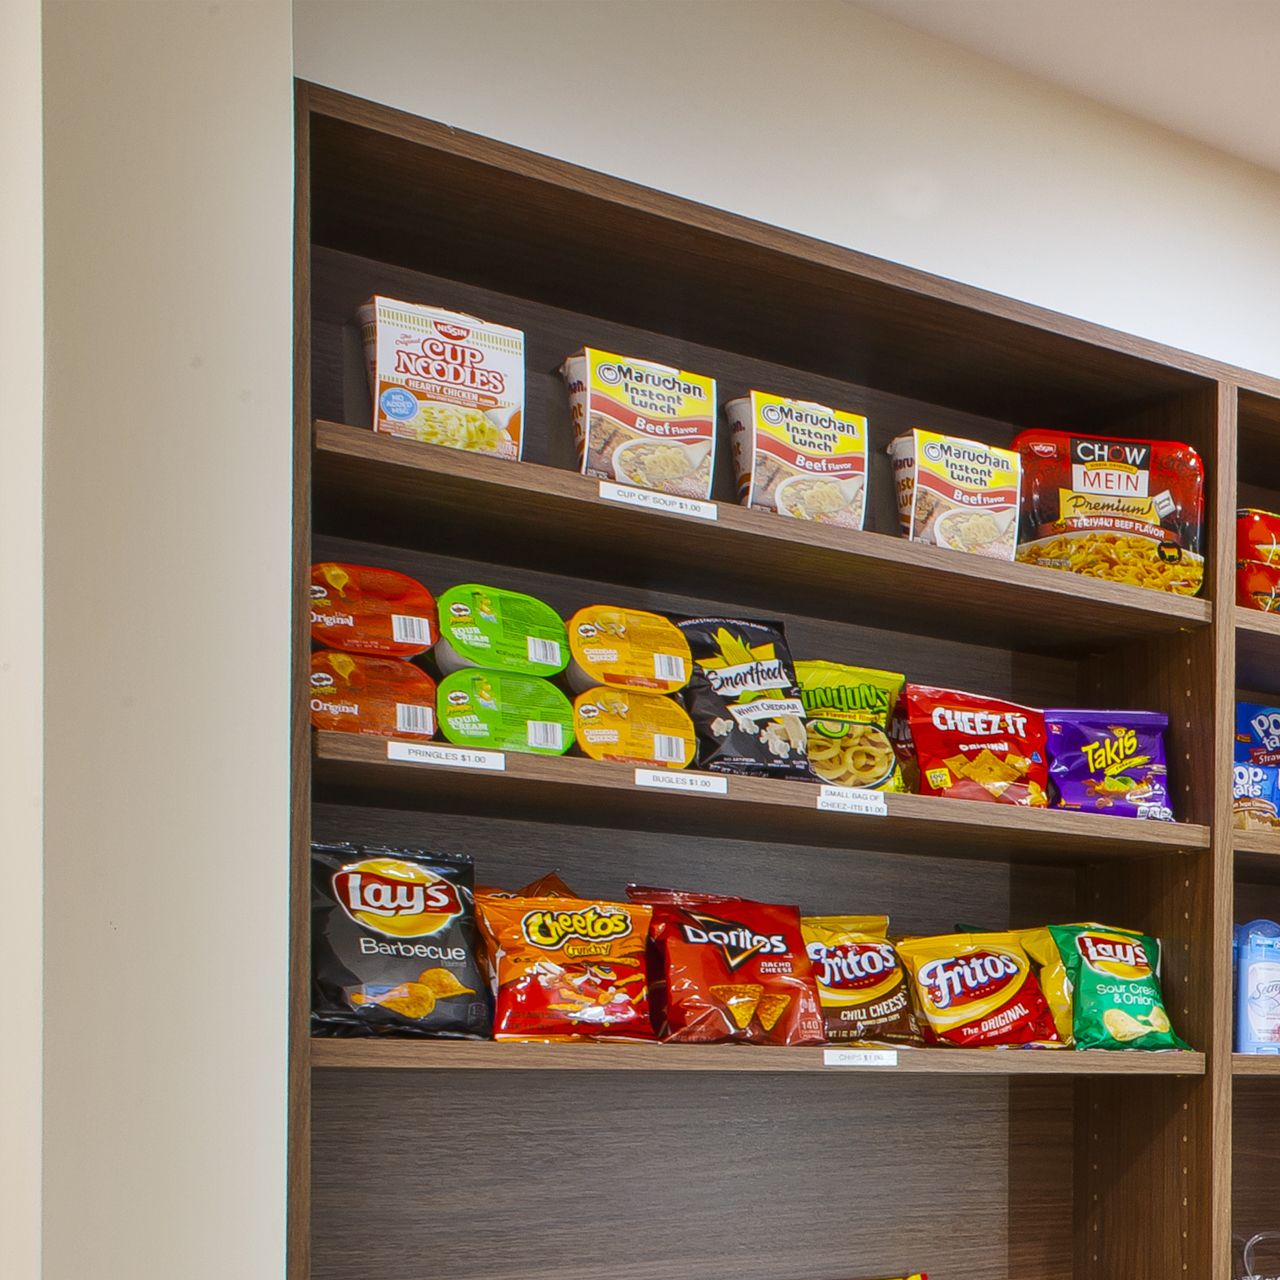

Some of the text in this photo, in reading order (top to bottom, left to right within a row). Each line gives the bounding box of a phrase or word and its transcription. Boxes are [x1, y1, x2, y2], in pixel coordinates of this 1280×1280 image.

[422, 338, 484, 367] CUP
[395, 350, 505, 394] NOODLES
[617, 364, 704, 398] Maruchan
[409, 380, 478, 401] HEARTY CHICKEN
[623, 383, 682, 406] Instant
[630, 394, 676, 416] Lunch
[635, 417, 697, 436] Beef Flavor
[779, 406, 857, 436] Maruchan
[785, 422, 838, 444] Instant
[791, 434, 832, 453] Lunch
[940, 443, 1011, 471] Maruchan
[1077, 443, 1147, 465] CHOW
[944, 458, 993, 478] Instant
[949, 470, 988, 487] Lunch
[1083, 471, 1139, 491] MEIN
[617, 489, 701, 512] CUP OF SOUP $1.00
[1067, 495, 1152, 515] Premium
[1072, 518, 1113, 529] TERIYAKI
[1135, 523, 1165, 538] FLAVOR
[707, 660, 785, 693] Smartfood
[310, 699, 359, 715] Original
[734, 700, 800, 717] WHITE CHEDDAR
[931, 706, 1028, 738] CHEEZ-IT
[408, 748, 486, 764] PRINGLES $1.00
[1081, 733, 1138, 774] Takis
[652, 774, 711, 788] BUGLES $1.00
[821, 801, 863, 811] CHEEZ-ITS
[348, 873, 449, 916] Lay's
[526, 907, 630, 947] Cheetos
[359, 937, 466, 961] Barbecue
[563, 941, 610, 957] Crunchy
[684, 922, 787, 957] Doritos
[1084, 937, 1148, 966] Lay's
[807, 942, 896, 989] Fritos
[918, 951, 1020, 1009] Fritos
[840, 996, 906, 1022] CHILI CHEESE
